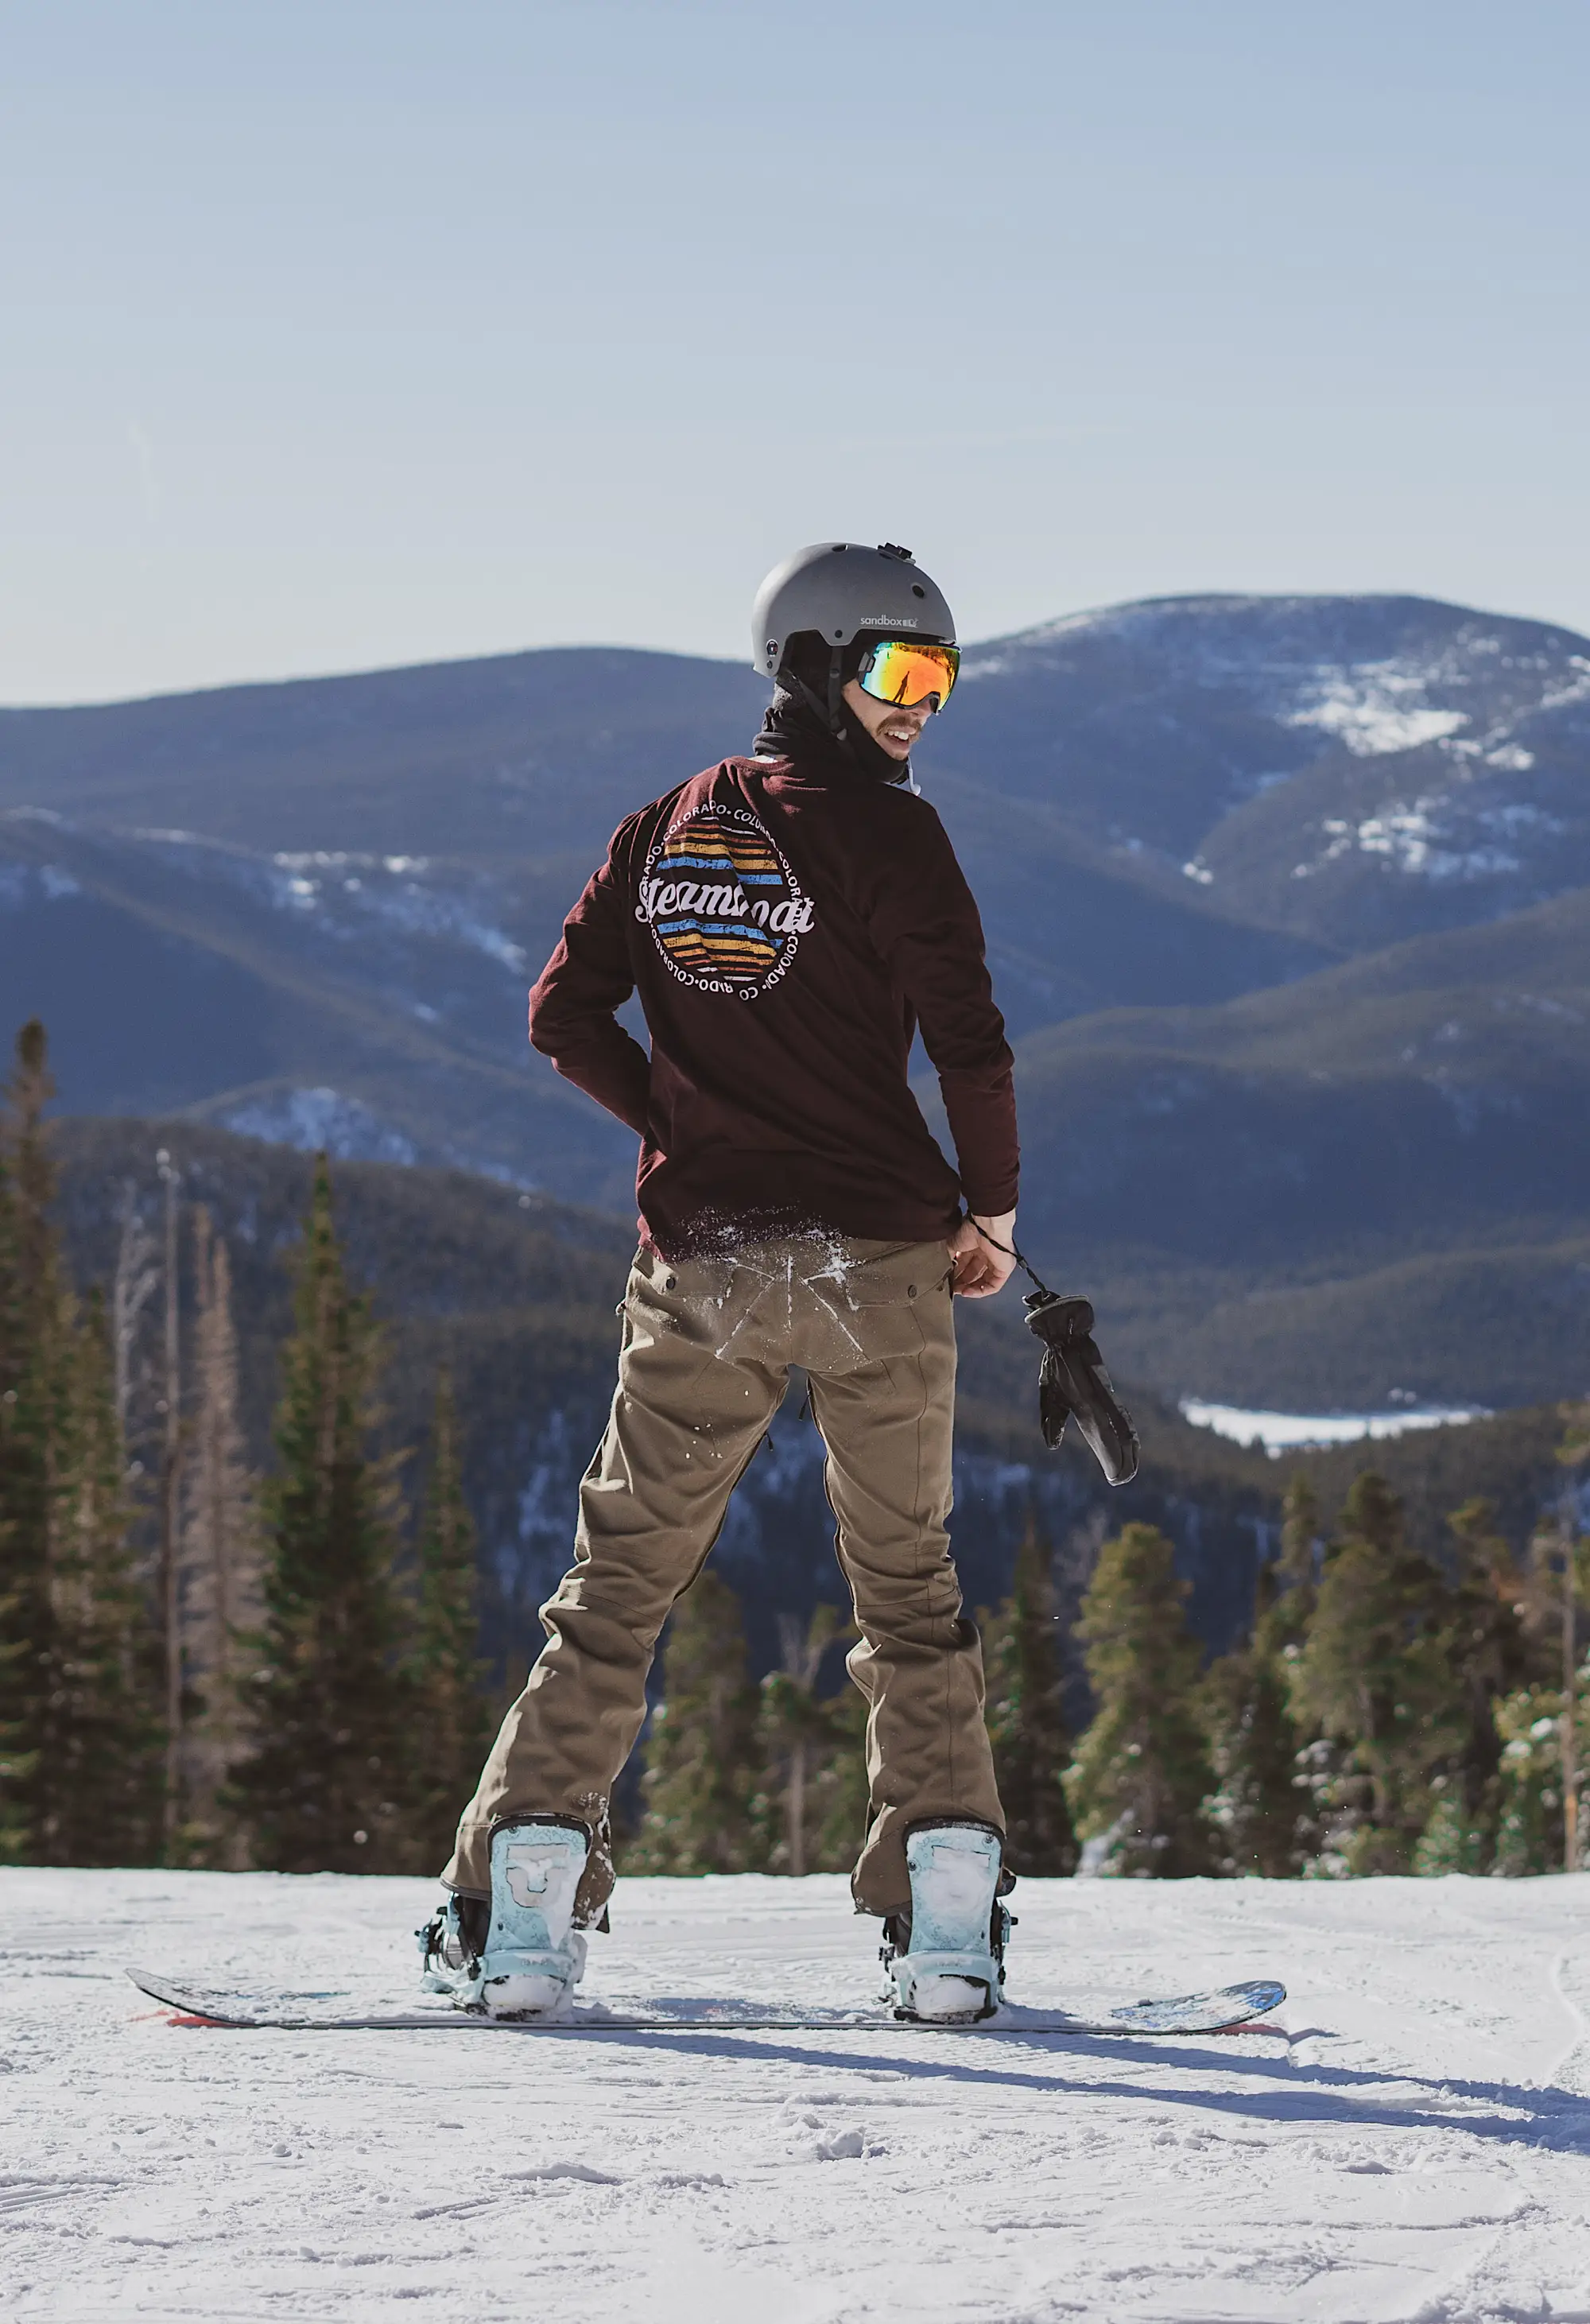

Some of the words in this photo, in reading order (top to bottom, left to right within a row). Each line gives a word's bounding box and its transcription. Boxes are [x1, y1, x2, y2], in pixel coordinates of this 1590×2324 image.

[860, 615, 902, 627] sandbox
[663, 800, 727, 842] COLORADO
[651, 928, 694, 986] COLORADO
[765, 936, 798, 989] COLOADO
